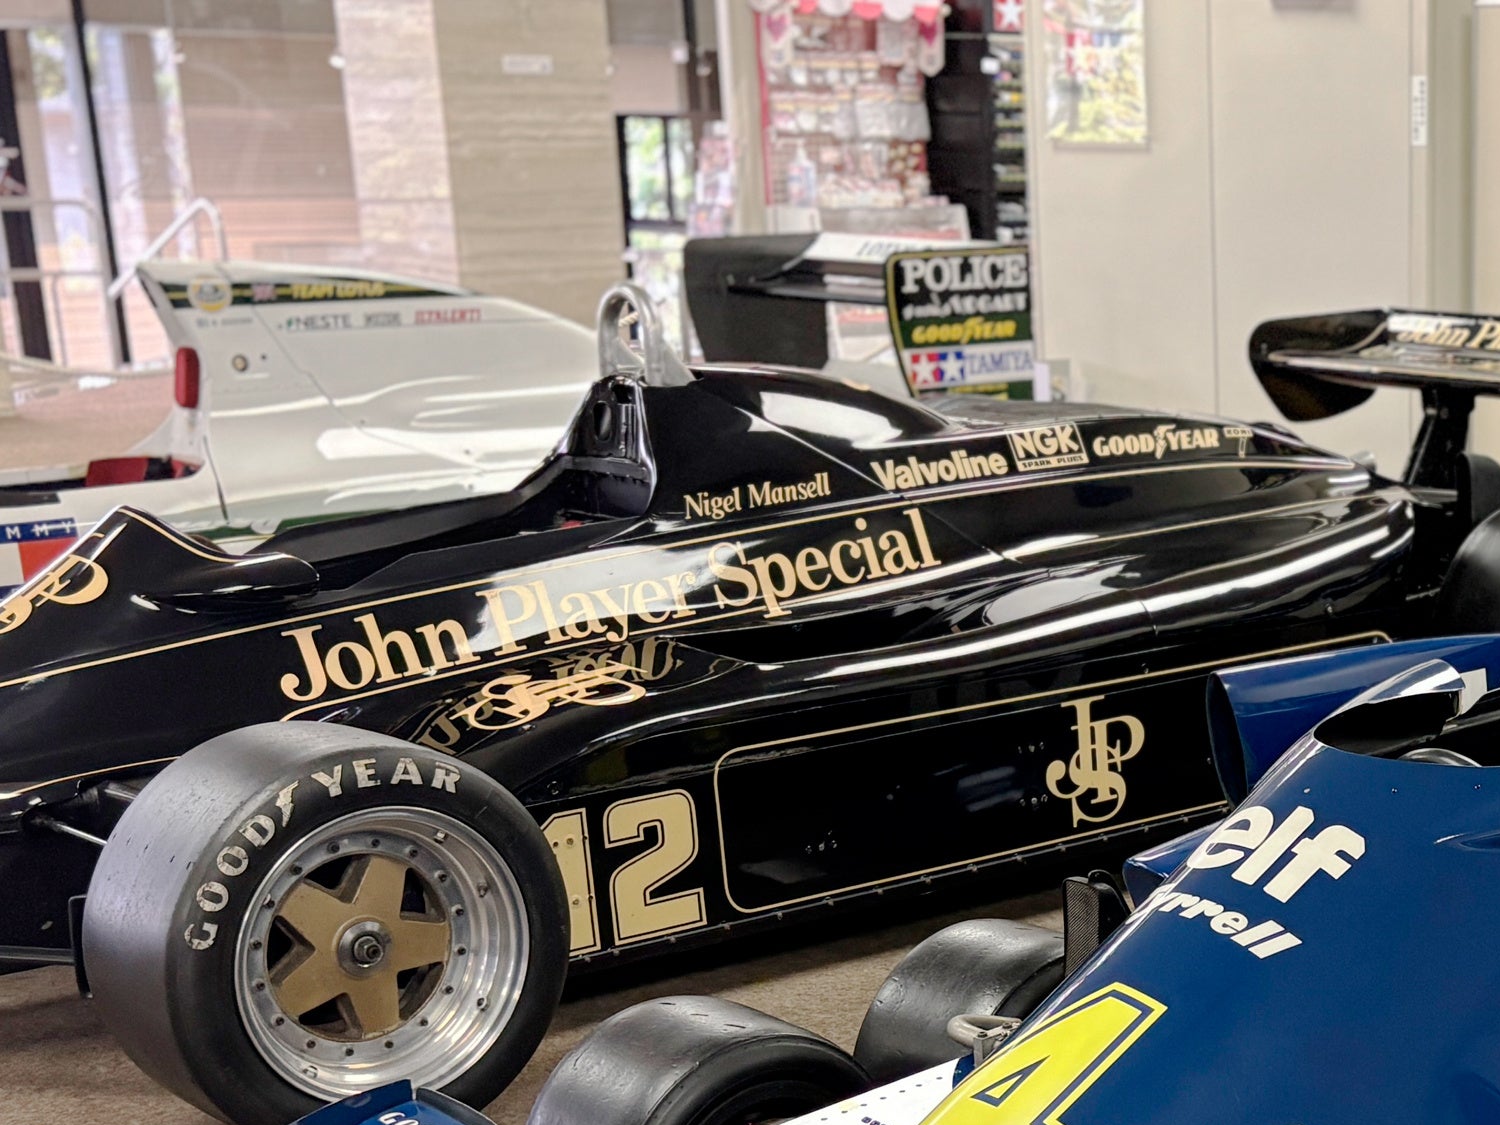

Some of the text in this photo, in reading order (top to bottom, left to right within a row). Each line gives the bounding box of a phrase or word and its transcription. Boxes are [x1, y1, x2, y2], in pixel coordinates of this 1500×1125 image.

[901, 254, 1029, 294] POLICE
[966, 350, 1034, 376] TAMIYA
[1011, 425, 1080, 458] NGK
[1022, 454, 1085, 470] SPARK PLUGS
[870, 450, 1010, 492] Valvoline
[683, 471, 832, 521] Nigel Mansell
[280, 611, 481, 703] John
[474, 570, 704, 656] Player
[707, 508, 942, 619] Special
[540, 788, 708, 957] 12
[1186, 805, 1366, 904] elf
